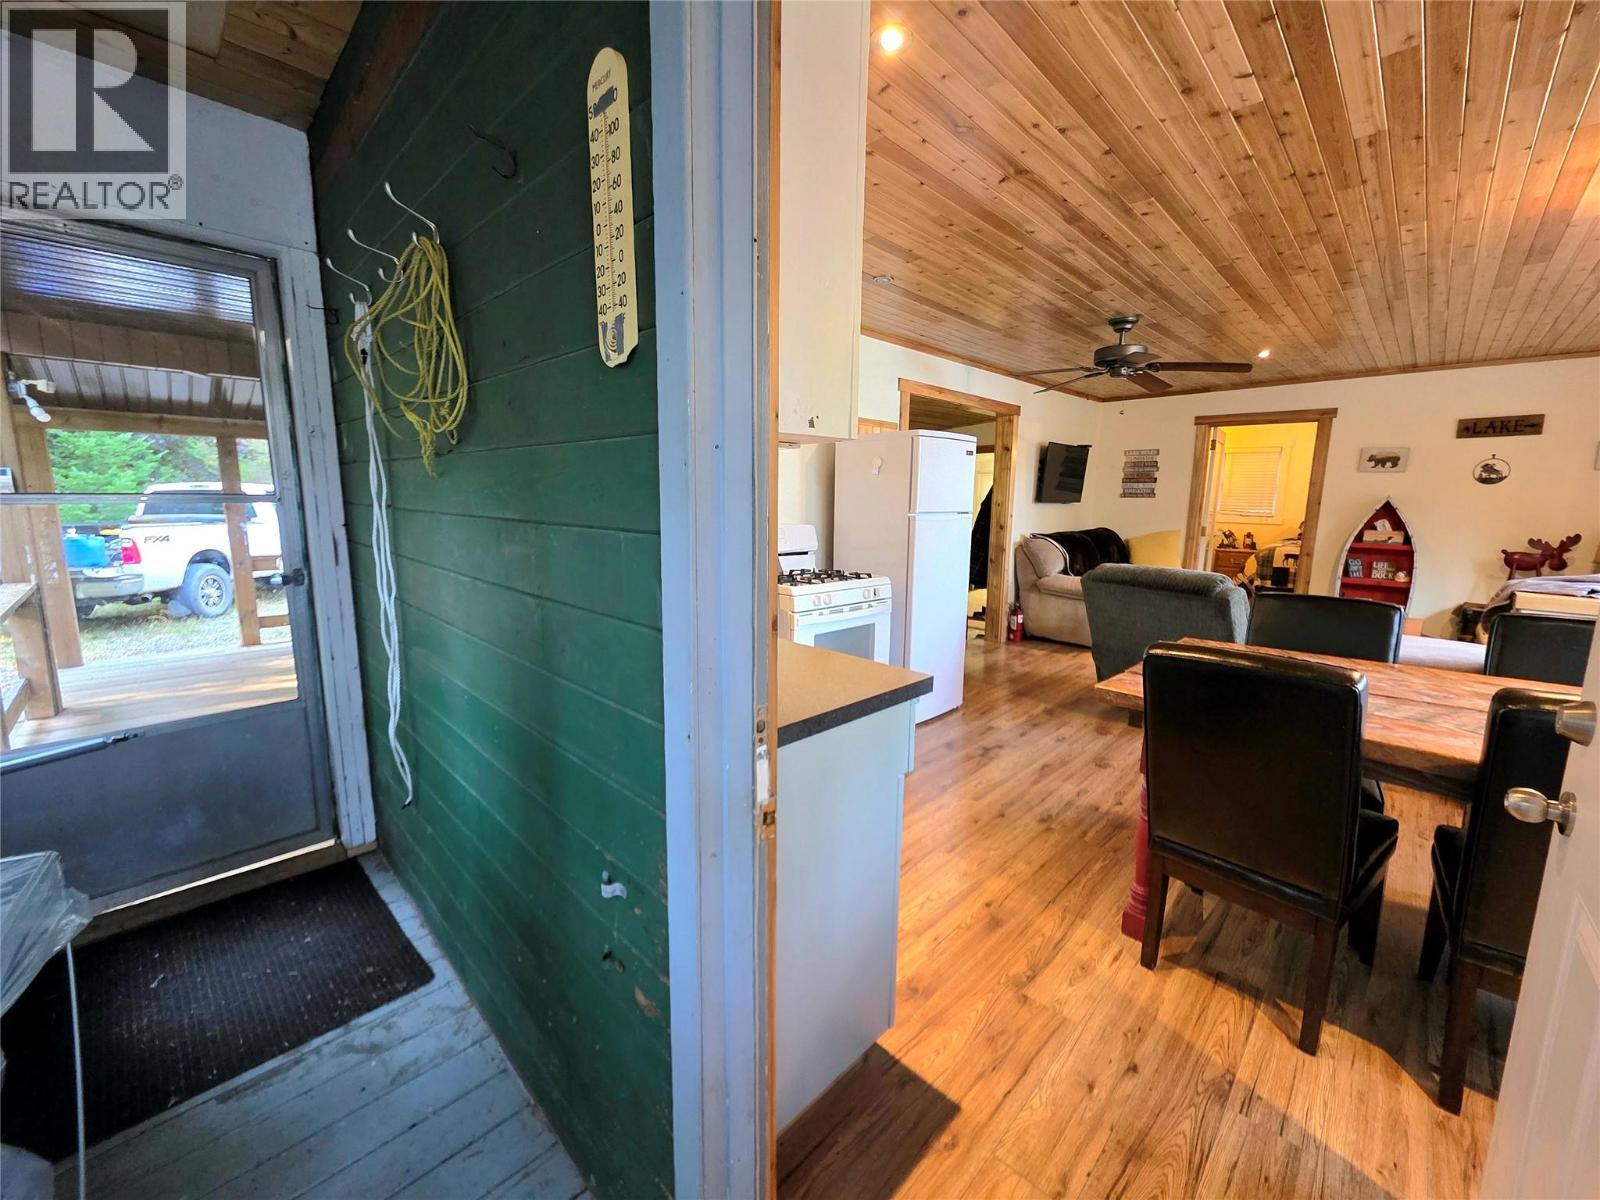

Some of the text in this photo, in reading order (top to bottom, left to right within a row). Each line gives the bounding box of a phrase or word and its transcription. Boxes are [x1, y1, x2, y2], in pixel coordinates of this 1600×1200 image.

[608, 117, 620, 136] 100
[590, 128, 599, 143] 40
[591, 153, 600, 169] 30
[611, 146, 621, 164] 80
[592, 177, 601, 193] 20
[612, 174, 621, 190] 60
[593, 201, 601, 216] 10
[613, 199, 623, 215] 40
[596, 223, 602, 236] 0
[615, 224, 624, 240] 20
[596, 244, 603, 257] 10
[619, 249, 624, 262] 0
[596, 265, 605, 279] 20
[617, 271, 626, 287] 20
[598, 284, 606, 298] 30
[618, 294, 627, 308] 40
[598, 303, 607, 316] 40
[1471, 419, 1525, 434] LAKE
